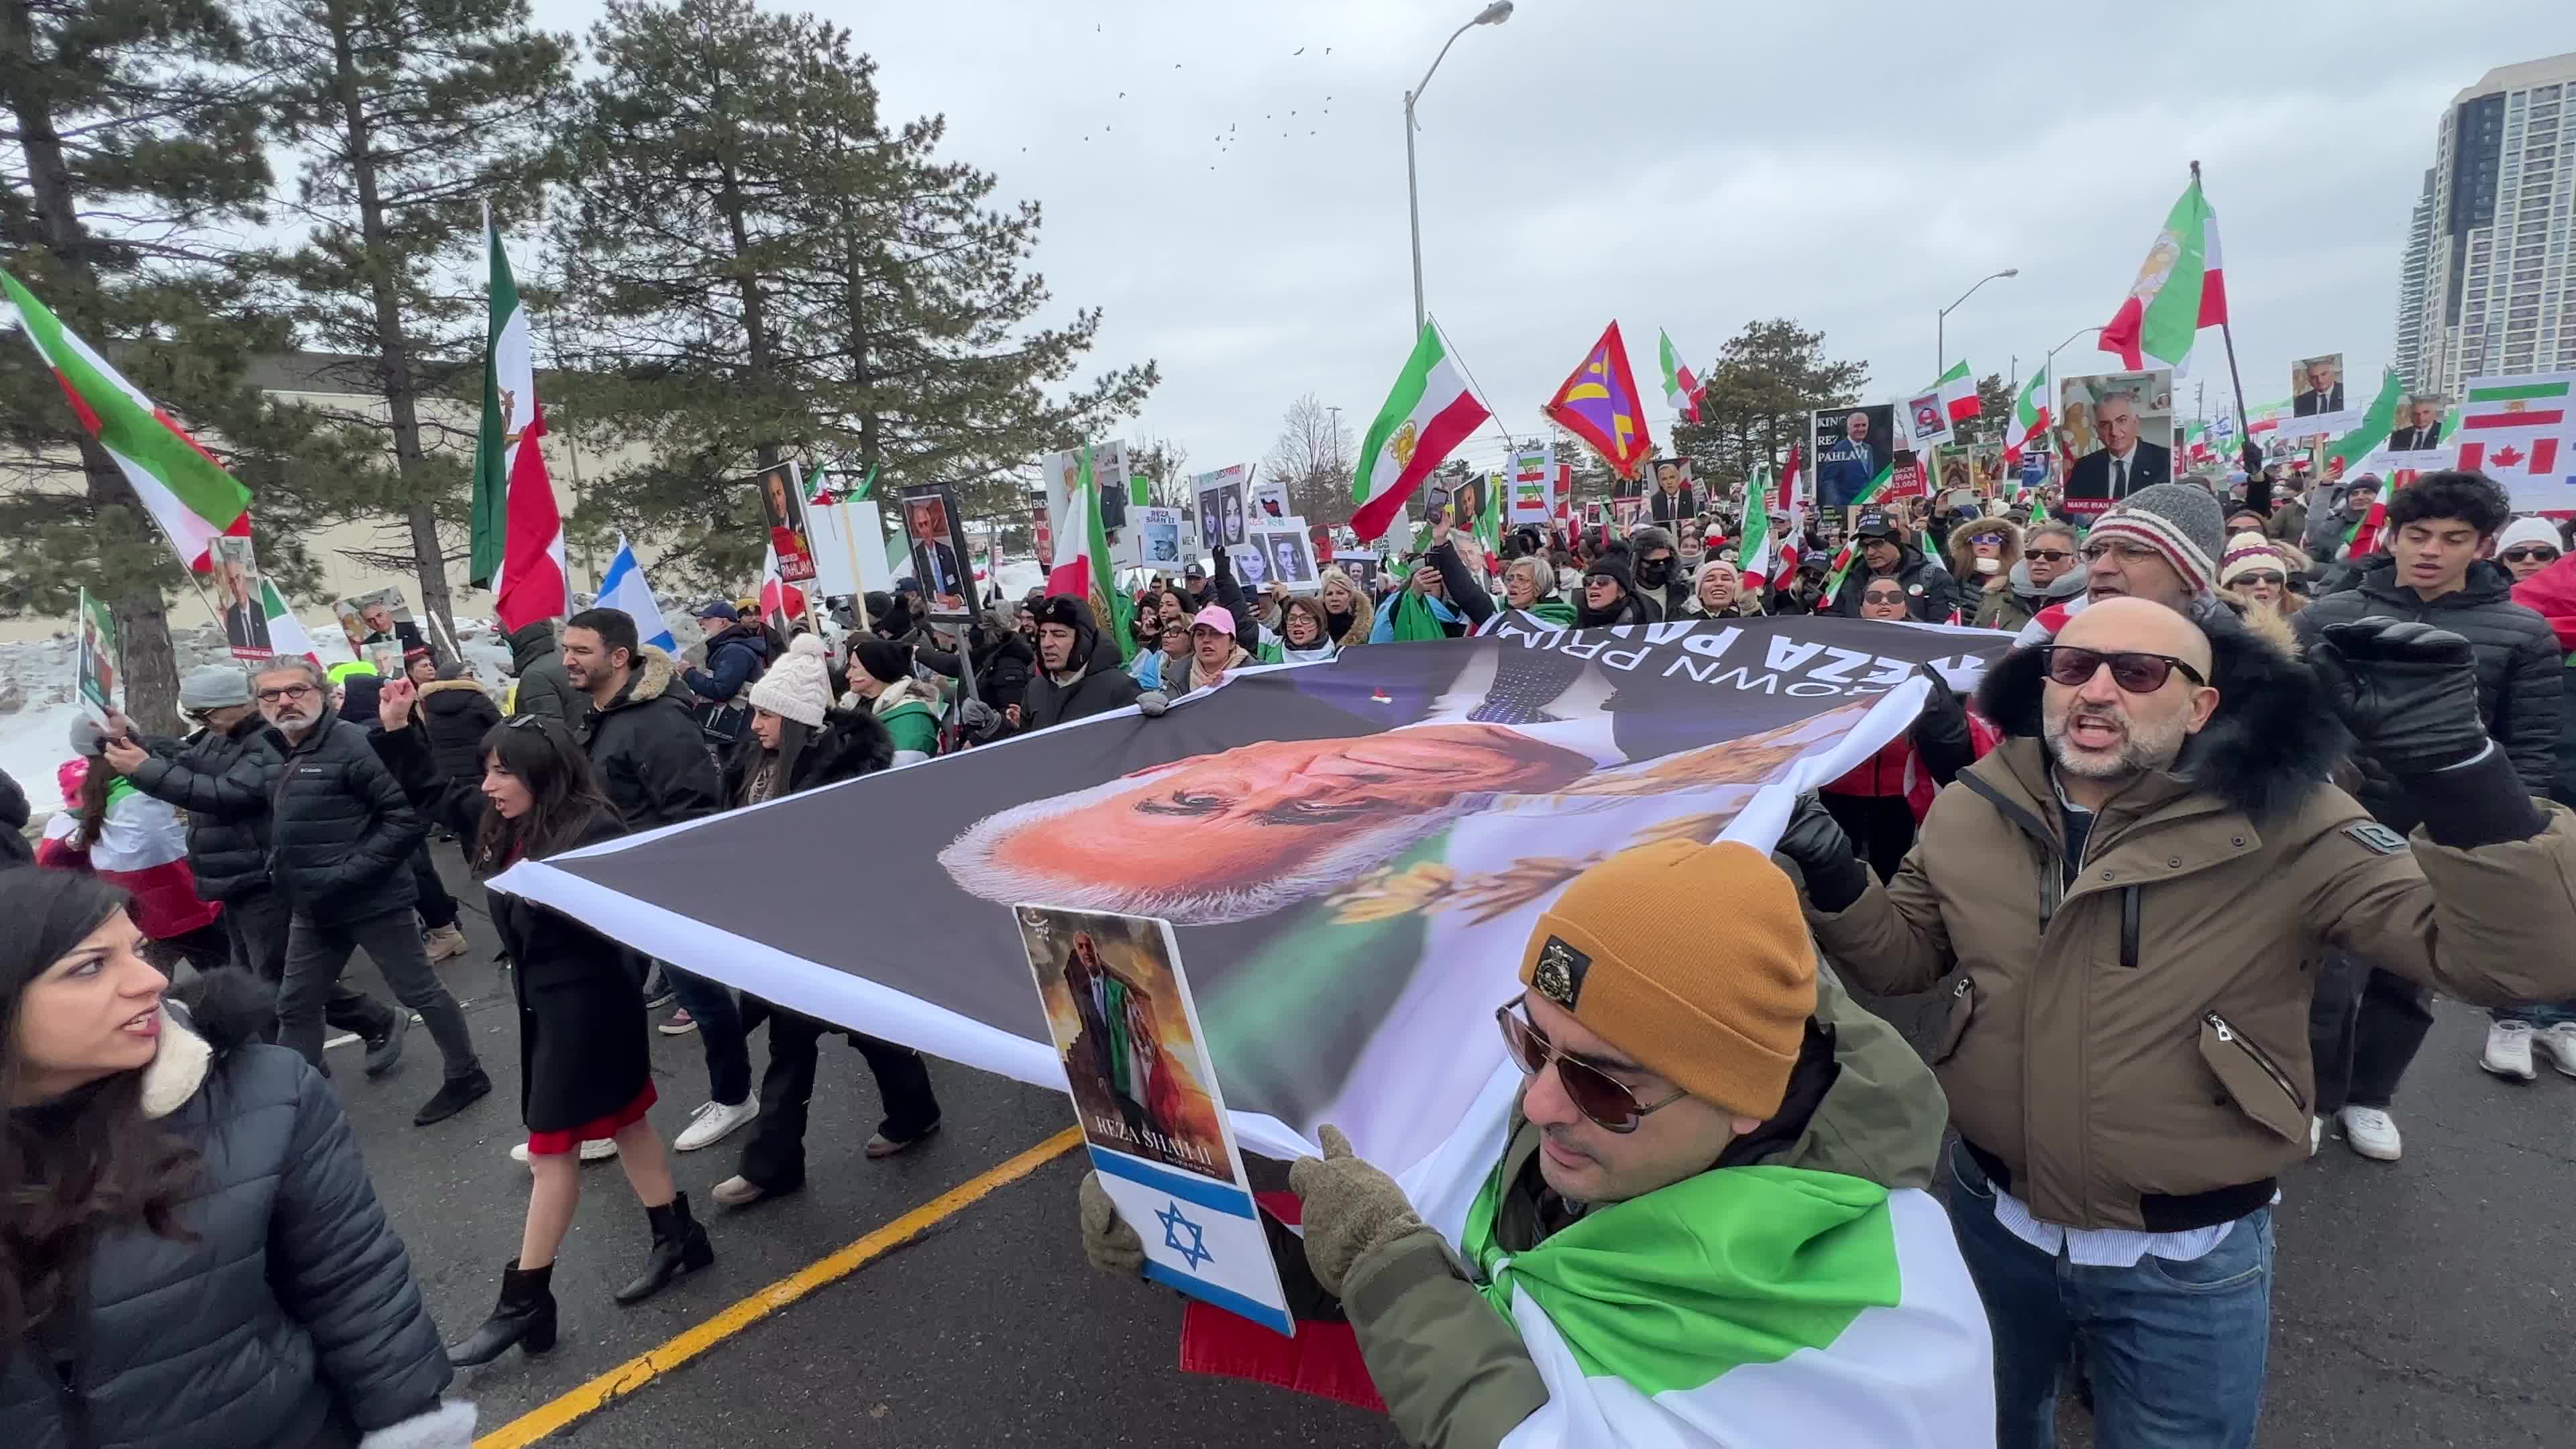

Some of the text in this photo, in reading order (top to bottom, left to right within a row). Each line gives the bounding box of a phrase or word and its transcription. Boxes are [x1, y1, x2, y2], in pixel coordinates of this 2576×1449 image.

[1817, 435, 1838, 446] REZ
[1817, 449, 1868, 462] PAHLAVI
[1095, 1114, 1214, 1165] REZA SHAH II
